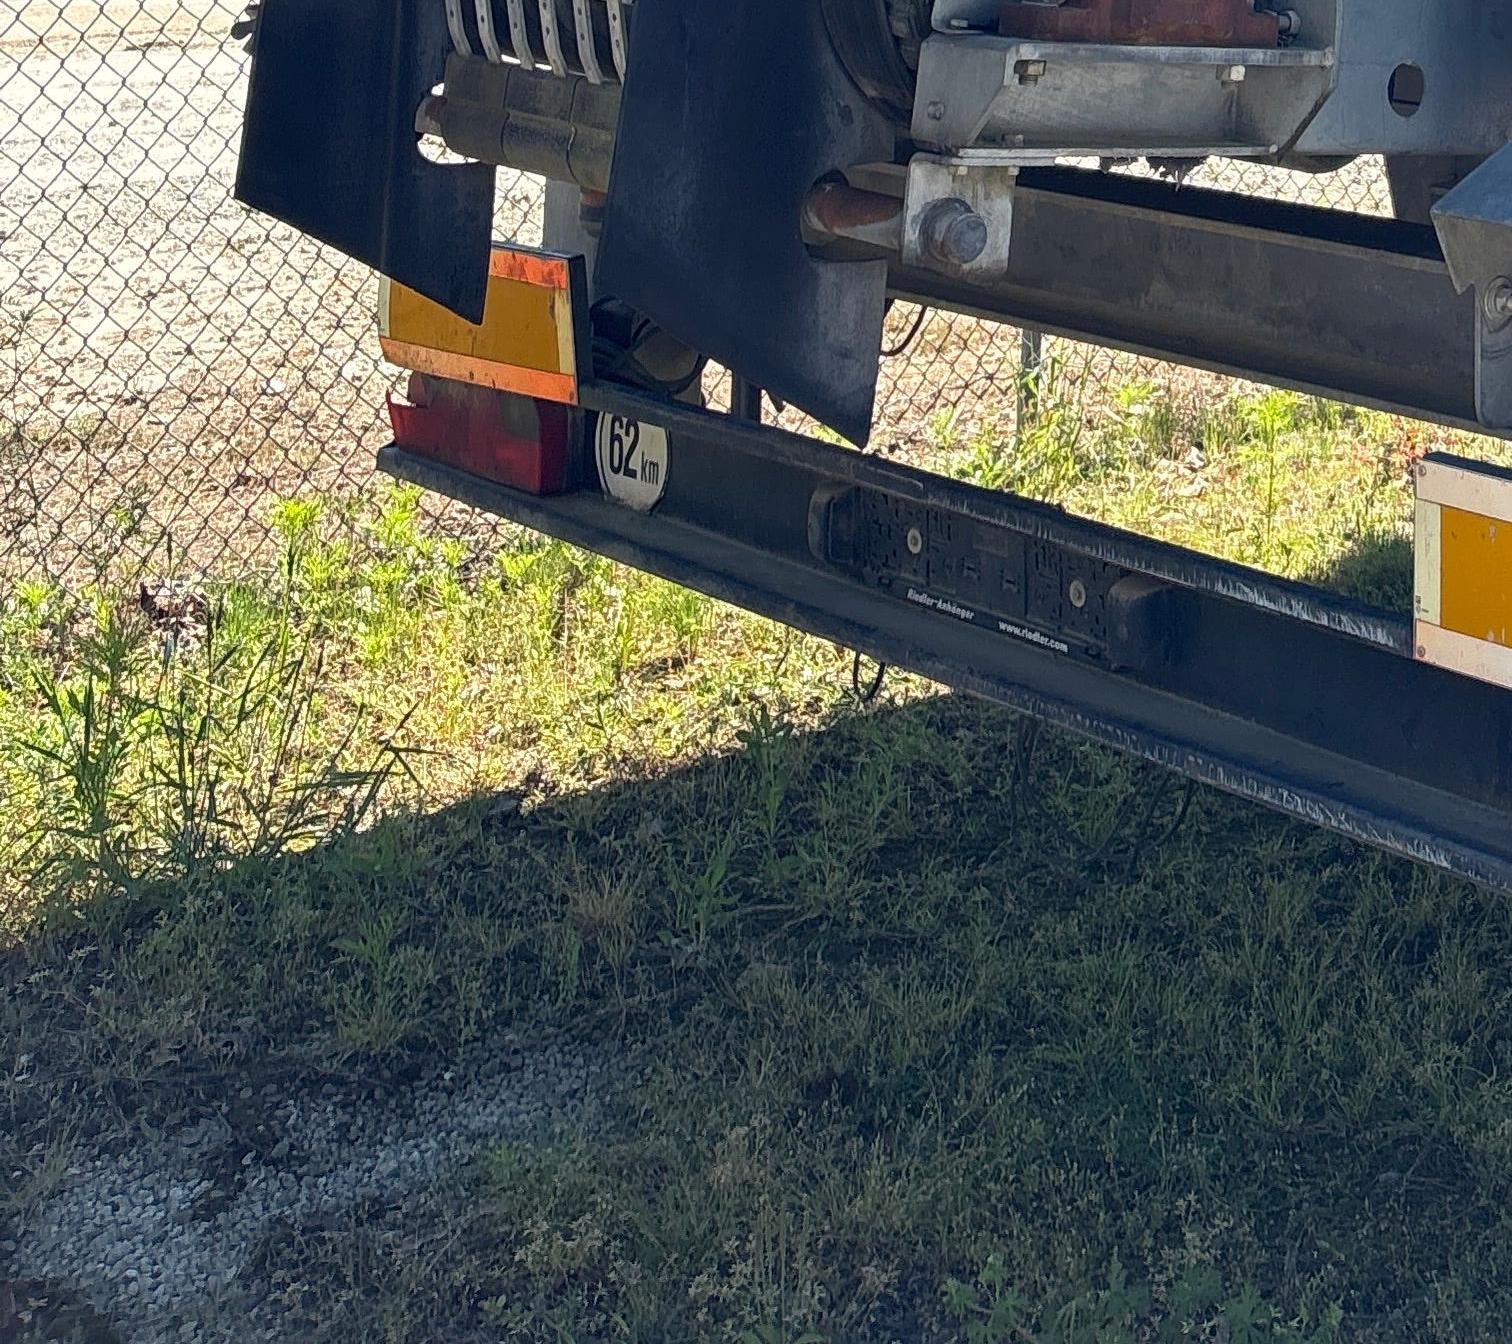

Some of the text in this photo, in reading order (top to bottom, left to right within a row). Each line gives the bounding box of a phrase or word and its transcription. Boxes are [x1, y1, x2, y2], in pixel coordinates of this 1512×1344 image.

[609, 415, 659, 486] 62 km
[998, 620, 1068, 653] www.riedler.com
